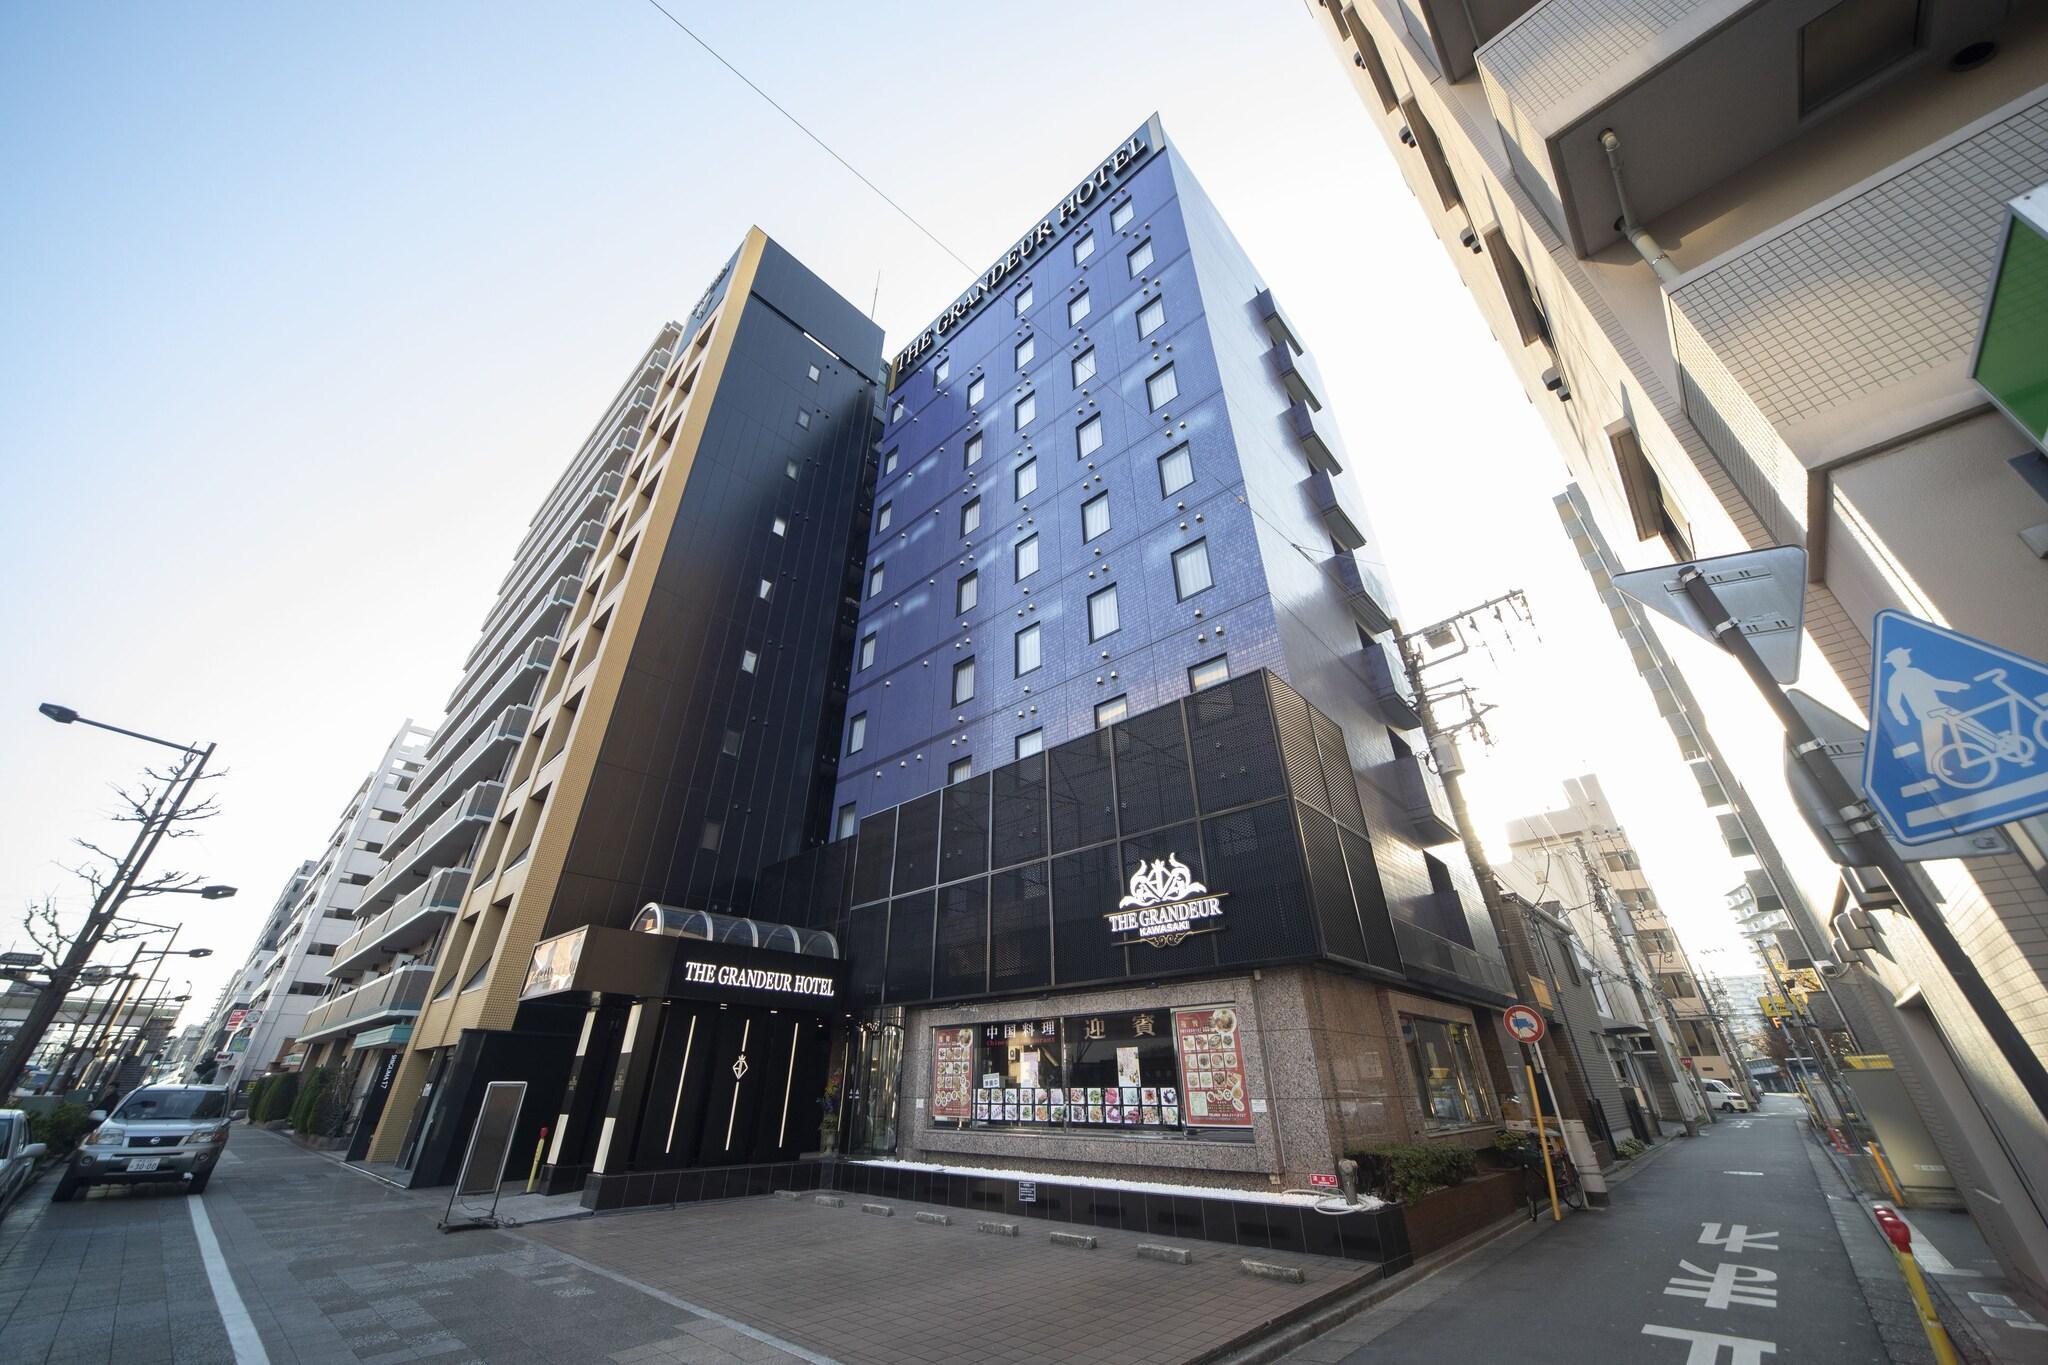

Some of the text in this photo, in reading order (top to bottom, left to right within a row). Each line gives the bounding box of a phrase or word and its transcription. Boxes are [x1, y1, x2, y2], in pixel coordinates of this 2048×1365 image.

[897, 136, 1146, 373] THE GRANDEUR HOTEL
[1109, 898, 1223, 932] THE GRANDEUR
[1140, 920, 1190, 937] KAWASAKI
[685, 961, 835, 997] THE GRANDEUR HOTEL
[986, 1019, 1056, 1040] 中国料理
